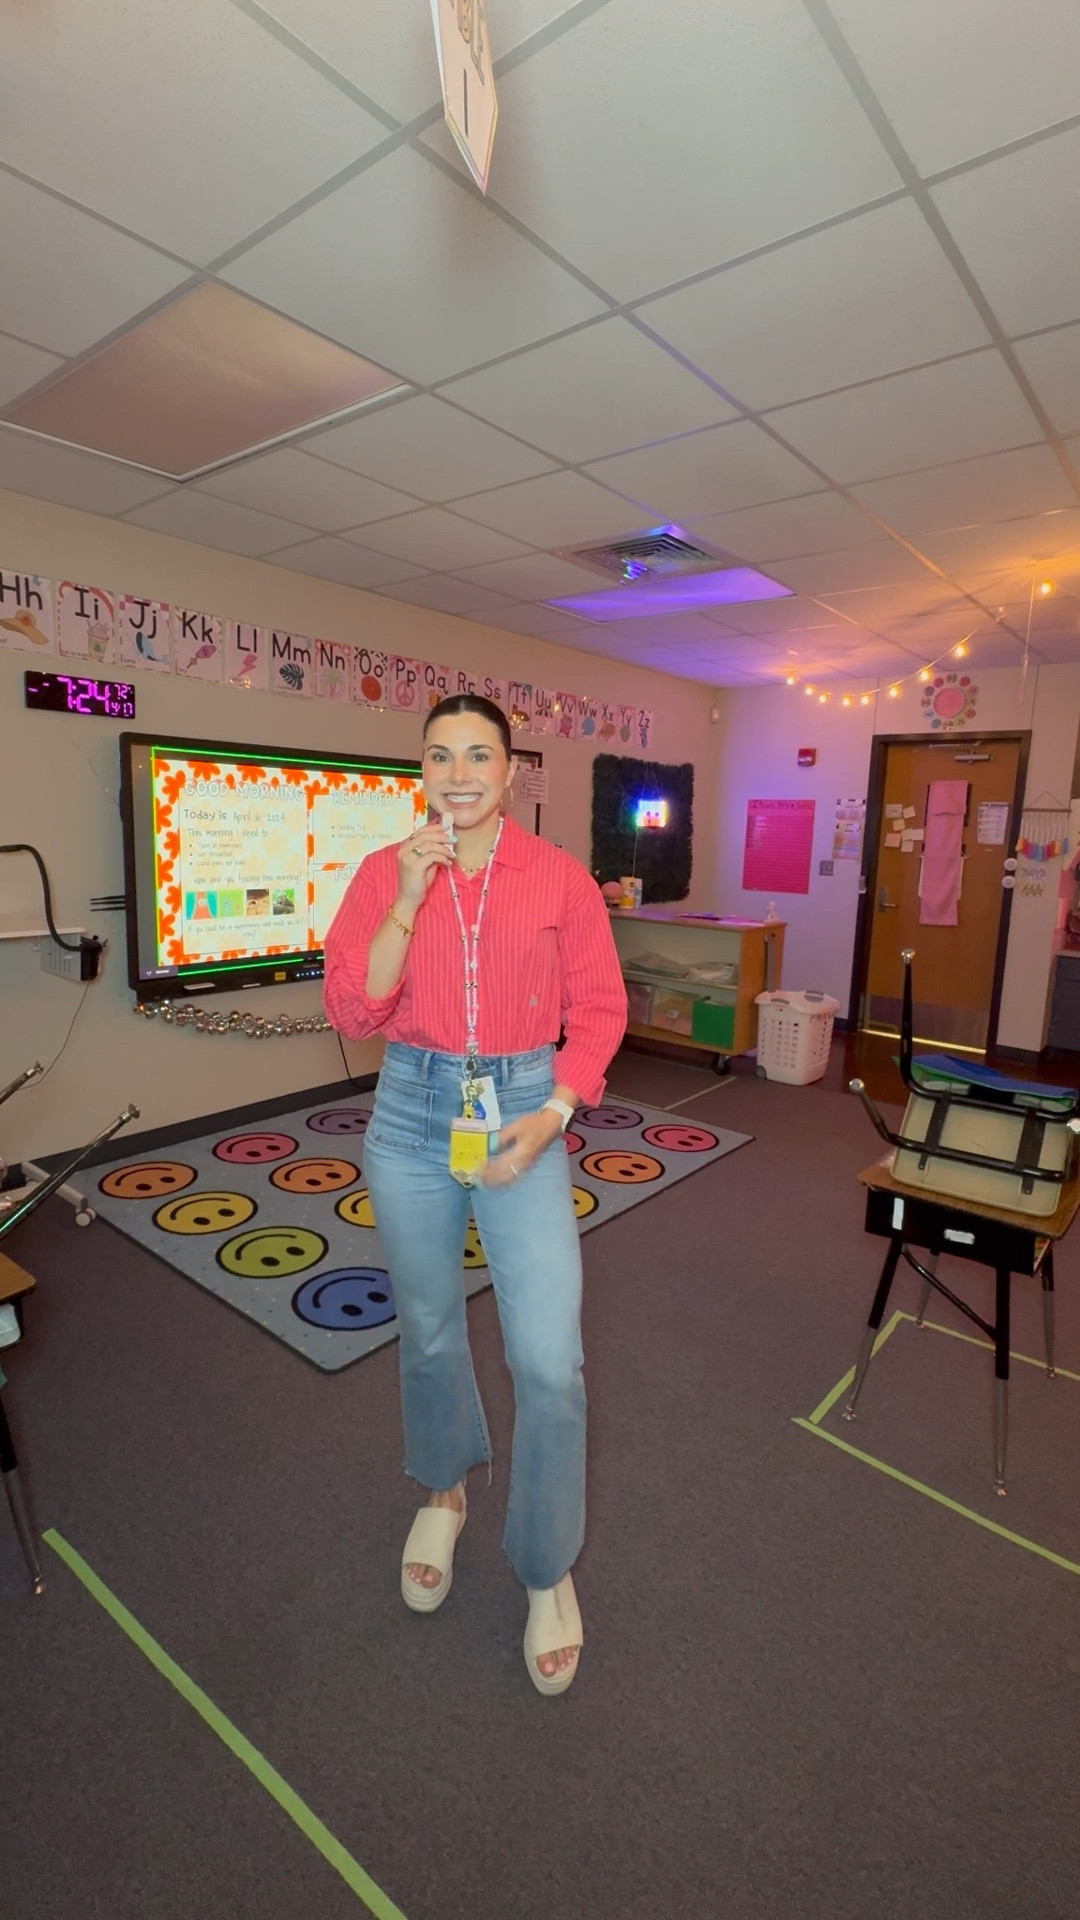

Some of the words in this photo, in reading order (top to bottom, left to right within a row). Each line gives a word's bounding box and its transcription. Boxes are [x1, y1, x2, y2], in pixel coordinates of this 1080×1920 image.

[0, 571, 43, 610] Hh
[74, 586, 99, 620] Ii
[129, 600, 157, 639] Jj
[182, 611, 213, 644] Kk
[237, 624, 257, 653] Ll
[272, 633, 311, 664] Mm
[320, 643, 345, 670] Nn
[359, 652, 384, 678] Oo
[396, 659, 416, 687] Pp
[425, 665, 448, 694] Qq
[458, 672, 475, 694] Rr
[57, 676, 109, 714] 7:24
[484, 677, 501, 699] Ss
[513, 682, 528, 704] Tt
[536, 689, 551, 709] Uu
[560, 698, 573, 713] Vv
[578, 700, 597, 718] Ww
[602, 704, 614, 721] Xx
[620, 706, 631, 727] Yy
[639, 710, 650, 728] Zz
[184, 779, 229, 797] GOOD
[235, 782, 304, 801] MORNING
[333, 790, 400, 807] REMINDERS
[184, 809, 216, 821] Today
[219, 810, 227, 820] is
[233, 810, 251, 824] April
[206, 829, 233, 841] morning
